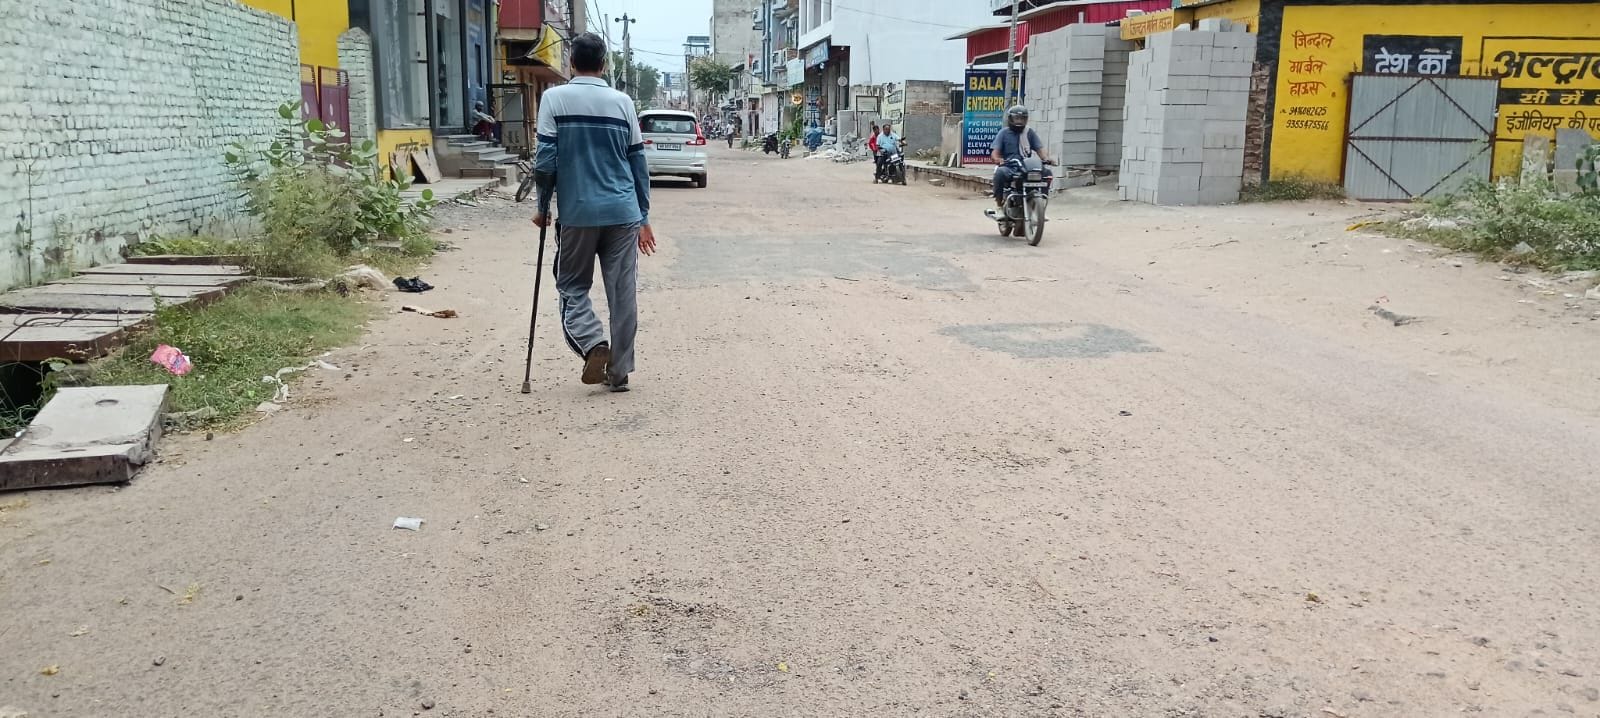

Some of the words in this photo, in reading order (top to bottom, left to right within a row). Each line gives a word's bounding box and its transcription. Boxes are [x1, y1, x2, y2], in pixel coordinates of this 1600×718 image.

[1291, 29, 1334, 49] जिन्दल
[1288, 55, 1328, 75] मार्बल
[1375, 46, 1413, 74] देश
[969, 76, 1003, 91] BALA
[1519, 89, 1550, 104] सी
[1559, 90, 1585, 105] में
[1505, 109, 1565, 133] इंजीनियर
